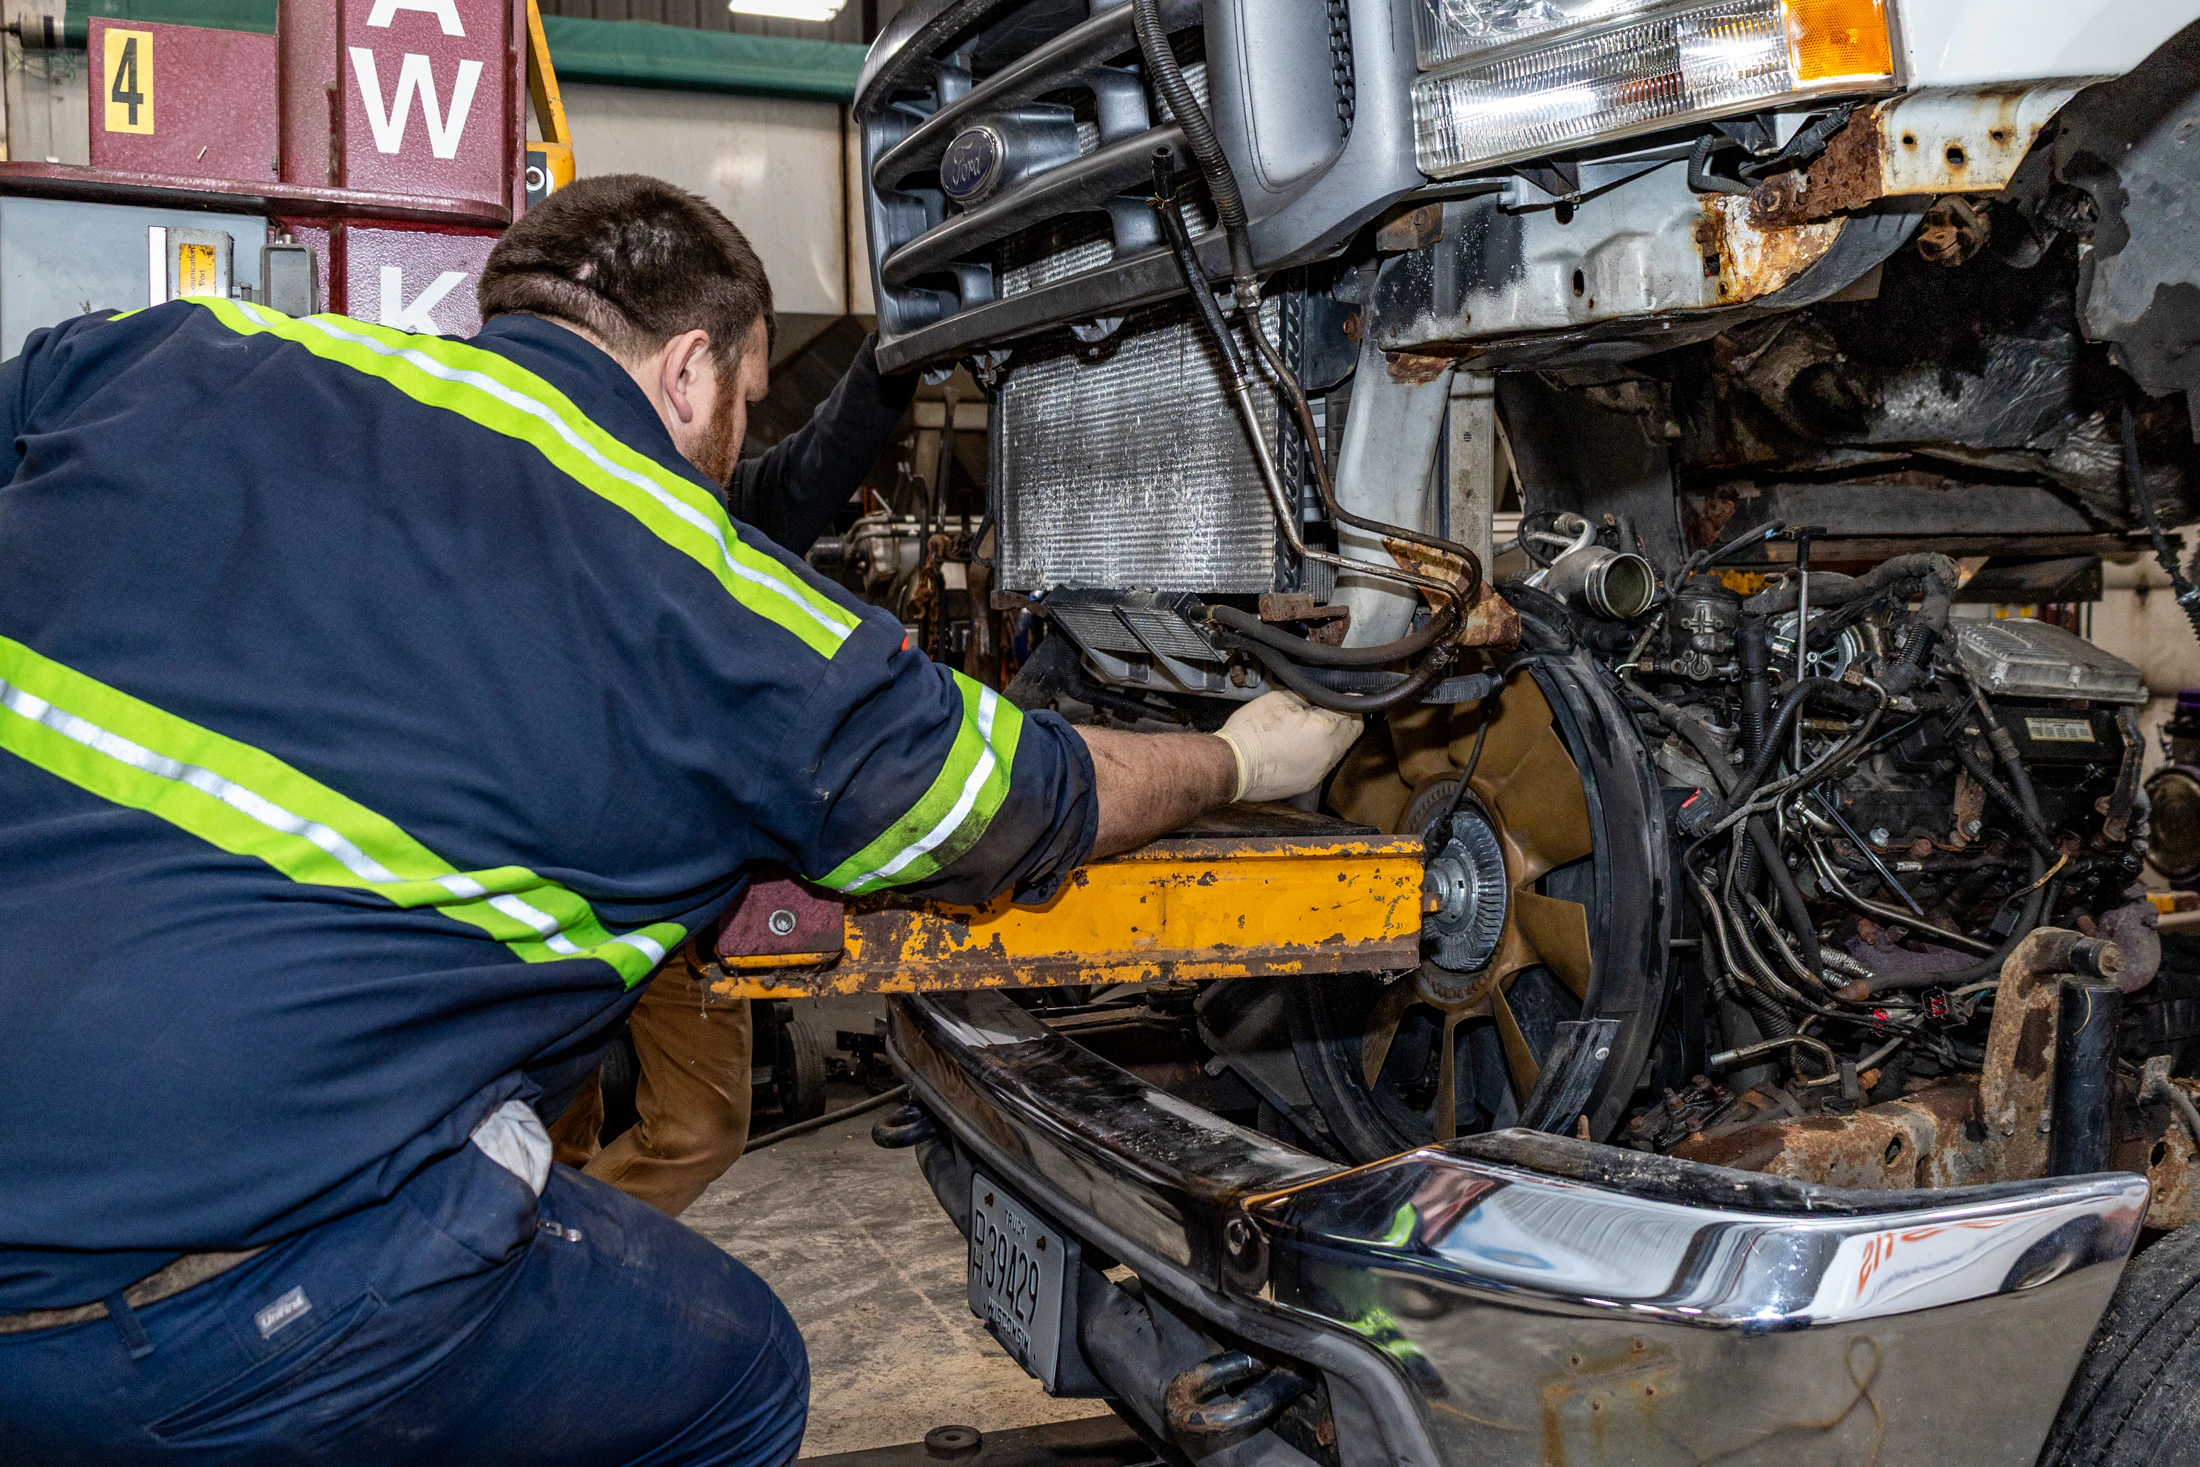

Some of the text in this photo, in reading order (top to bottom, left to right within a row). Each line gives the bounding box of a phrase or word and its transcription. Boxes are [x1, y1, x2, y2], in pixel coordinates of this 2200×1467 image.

[111, 37, 144, 125] 4
[953, 142, 982, 186] Ford
[1005, 1209, 1028, 1241] TRUCK
[986, 1223, 1041, 1327] 39429
[988, 1296, 1031, 1356] WISCONSIN
